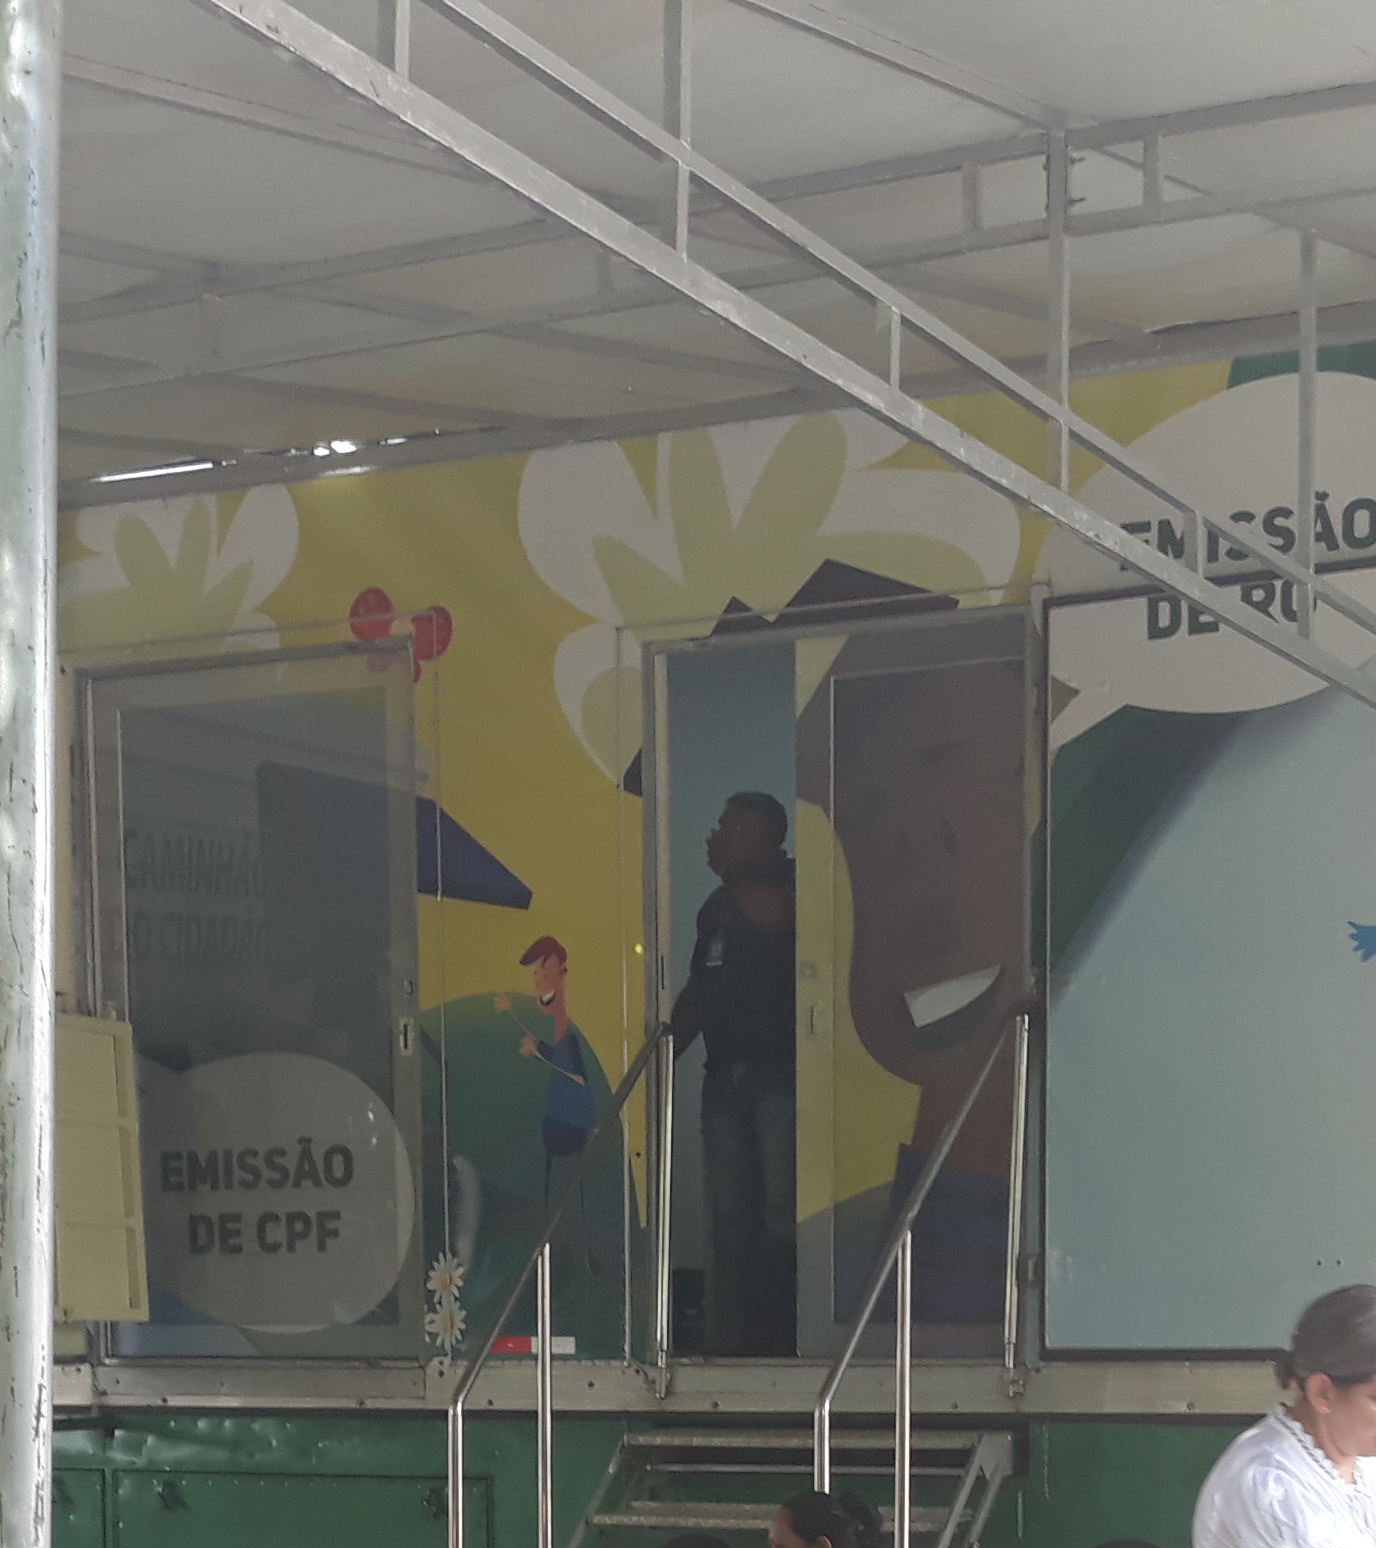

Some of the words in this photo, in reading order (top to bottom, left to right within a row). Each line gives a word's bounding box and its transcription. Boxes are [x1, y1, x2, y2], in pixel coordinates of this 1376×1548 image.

[160, 1135, 354, 1192] EMISSÃO
[188, 1212, 243, 1255] DE
[257, 1209, 342, 1254] CPF
